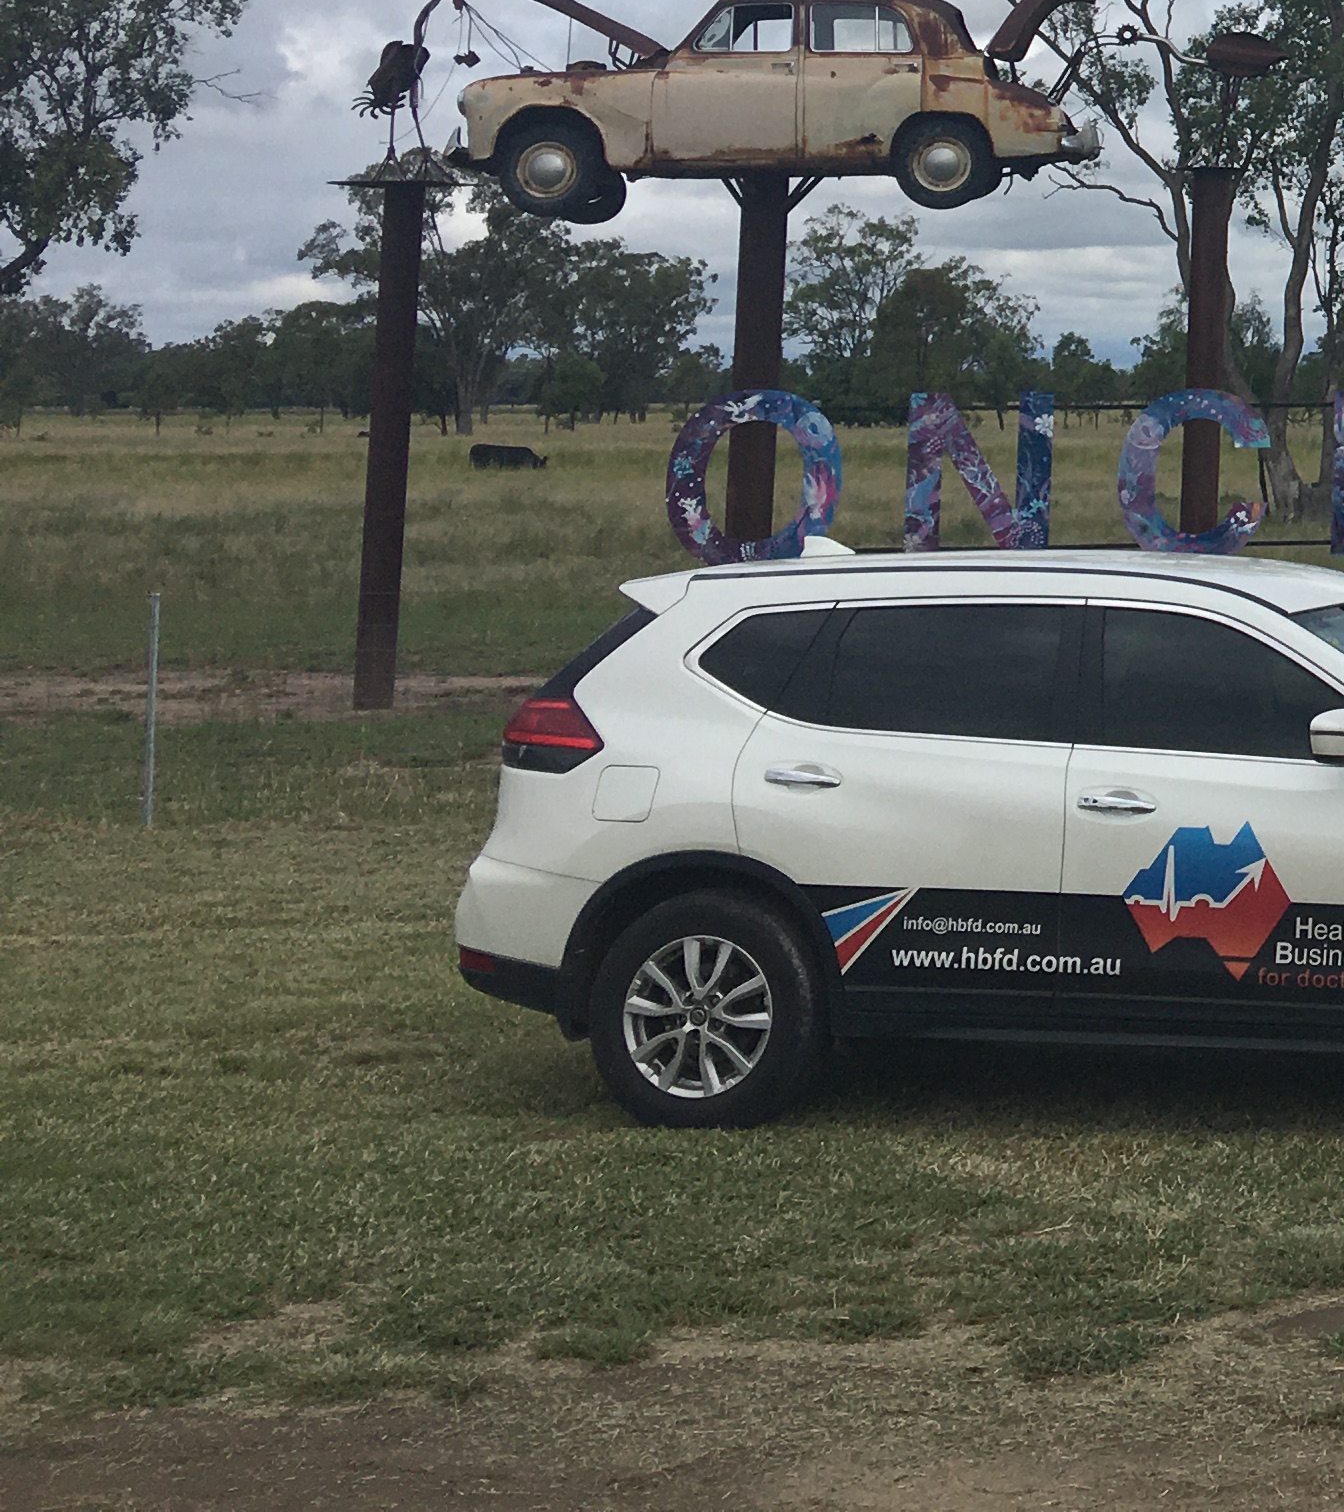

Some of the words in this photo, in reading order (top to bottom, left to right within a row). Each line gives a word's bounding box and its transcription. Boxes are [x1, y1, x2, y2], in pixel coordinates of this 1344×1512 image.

[903, 915, 1041, 935] info@hbfd.com.au
[891, 946, 1121, 976] www.hbfd.com.au
[1259, 968, 1290, 986] for
